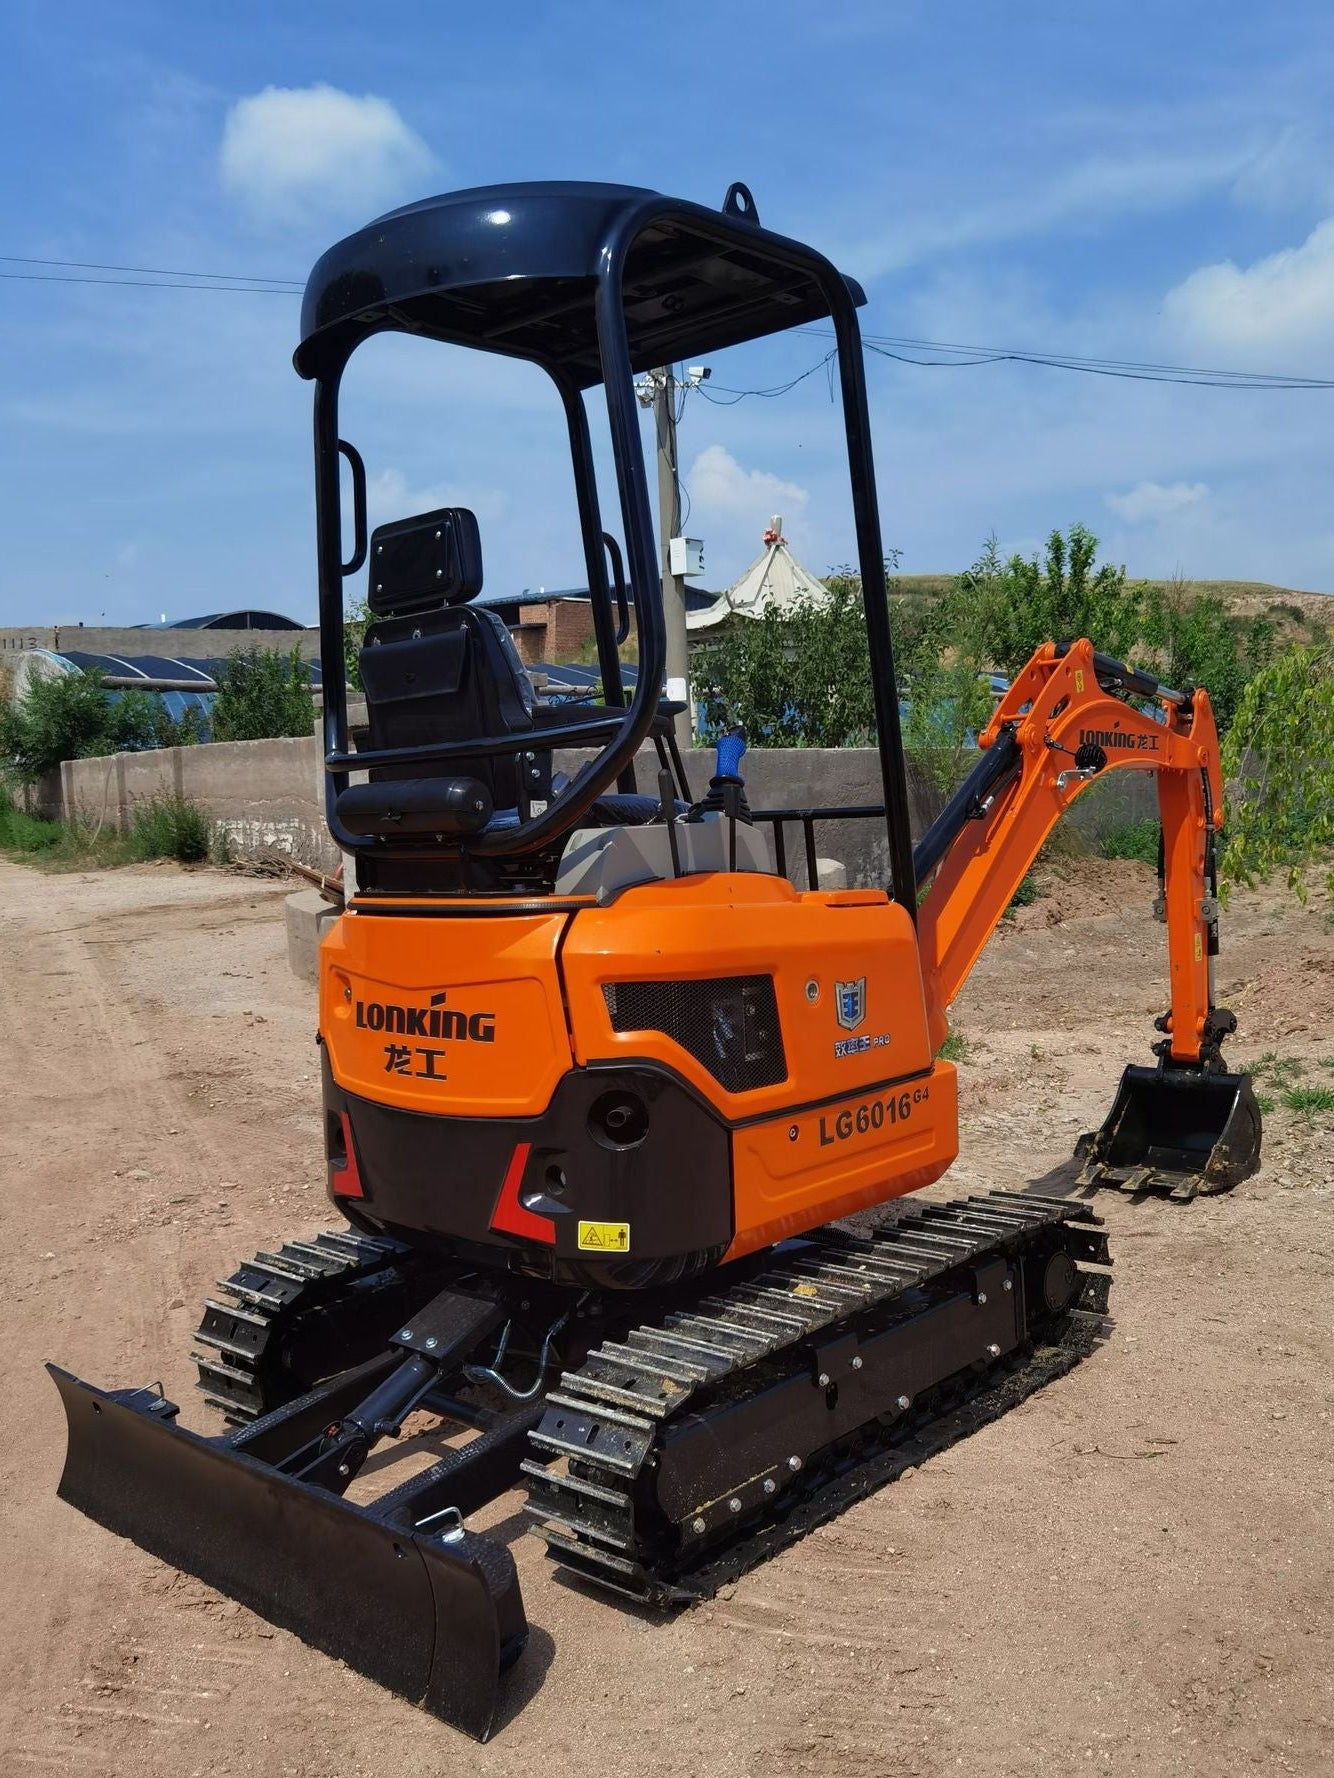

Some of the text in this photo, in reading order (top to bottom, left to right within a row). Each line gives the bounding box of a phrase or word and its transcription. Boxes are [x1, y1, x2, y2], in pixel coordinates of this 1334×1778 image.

[1137, 733, 1159, 750] 龙工
[356, 992, 496, 1043] LONKING
[384, 1044, 447, 1081] 龙工
